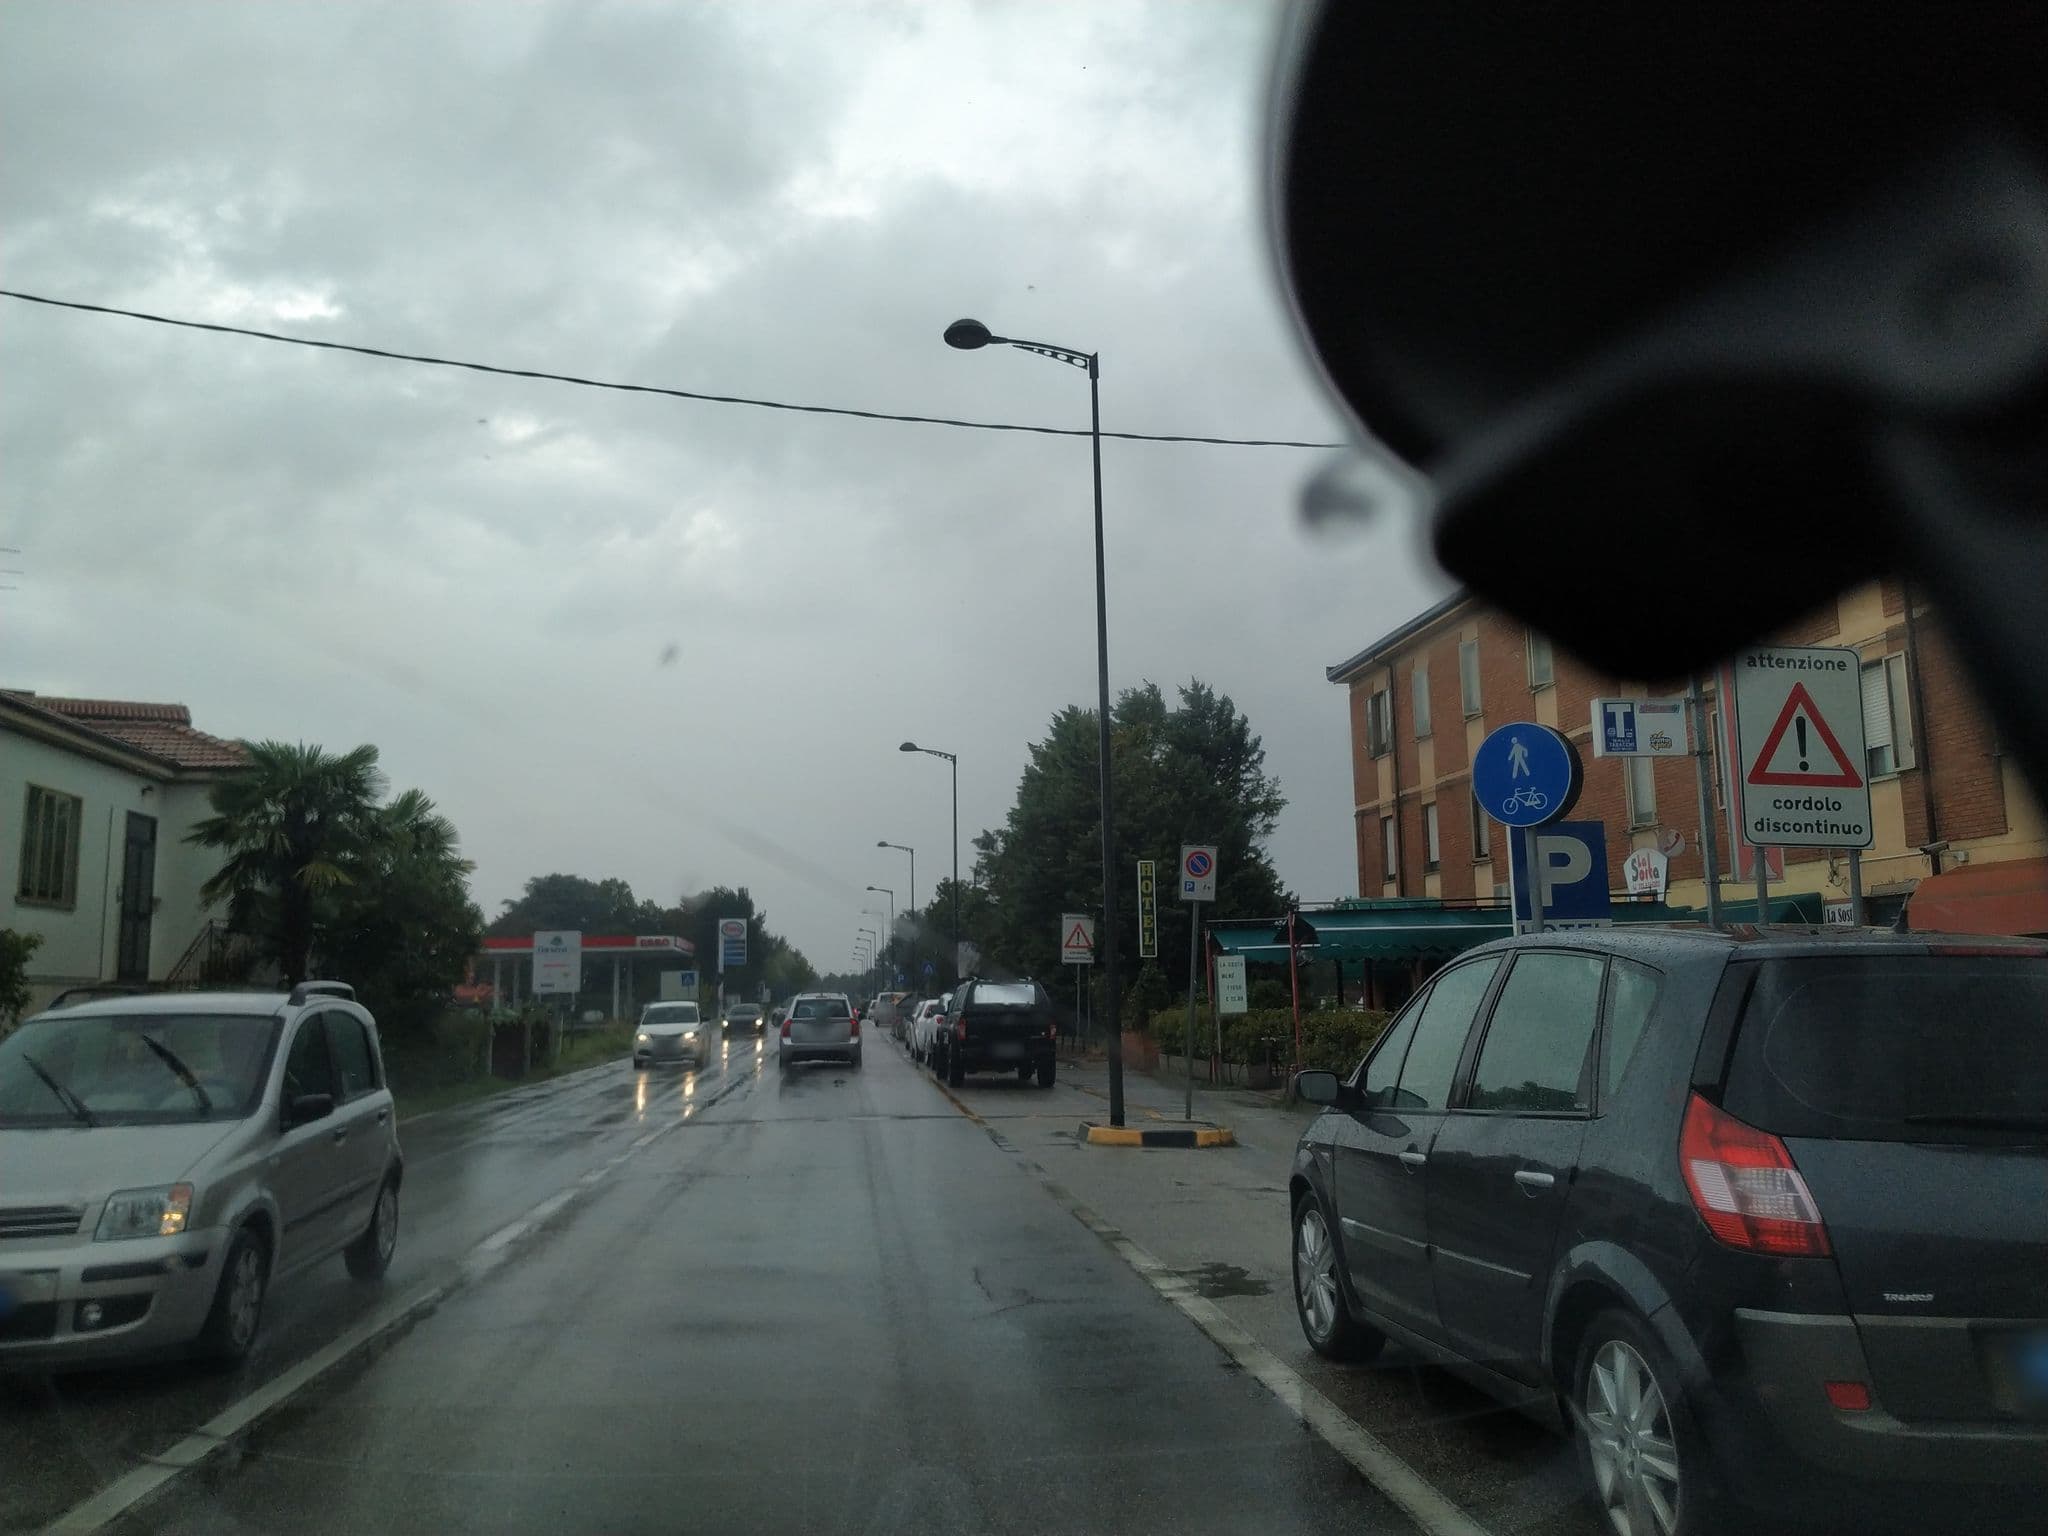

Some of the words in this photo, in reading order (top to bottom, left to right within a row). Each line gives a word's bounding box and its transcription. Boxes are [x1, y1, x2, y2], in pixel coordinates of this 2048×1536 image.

[1747, 655, 1848, 672] attenzione
[1607, 704, 1631, 738] T
[1773, 796, 1842, 811] cordolo
[1754, 818, 1864, 835] discontinuo
[1537, 836, 1592, 907] P
[1141, 863, 1154, 945] HOTEL
[1826, 909, 1836, 923] La
[1838, 908, 1854, 922] Sost
